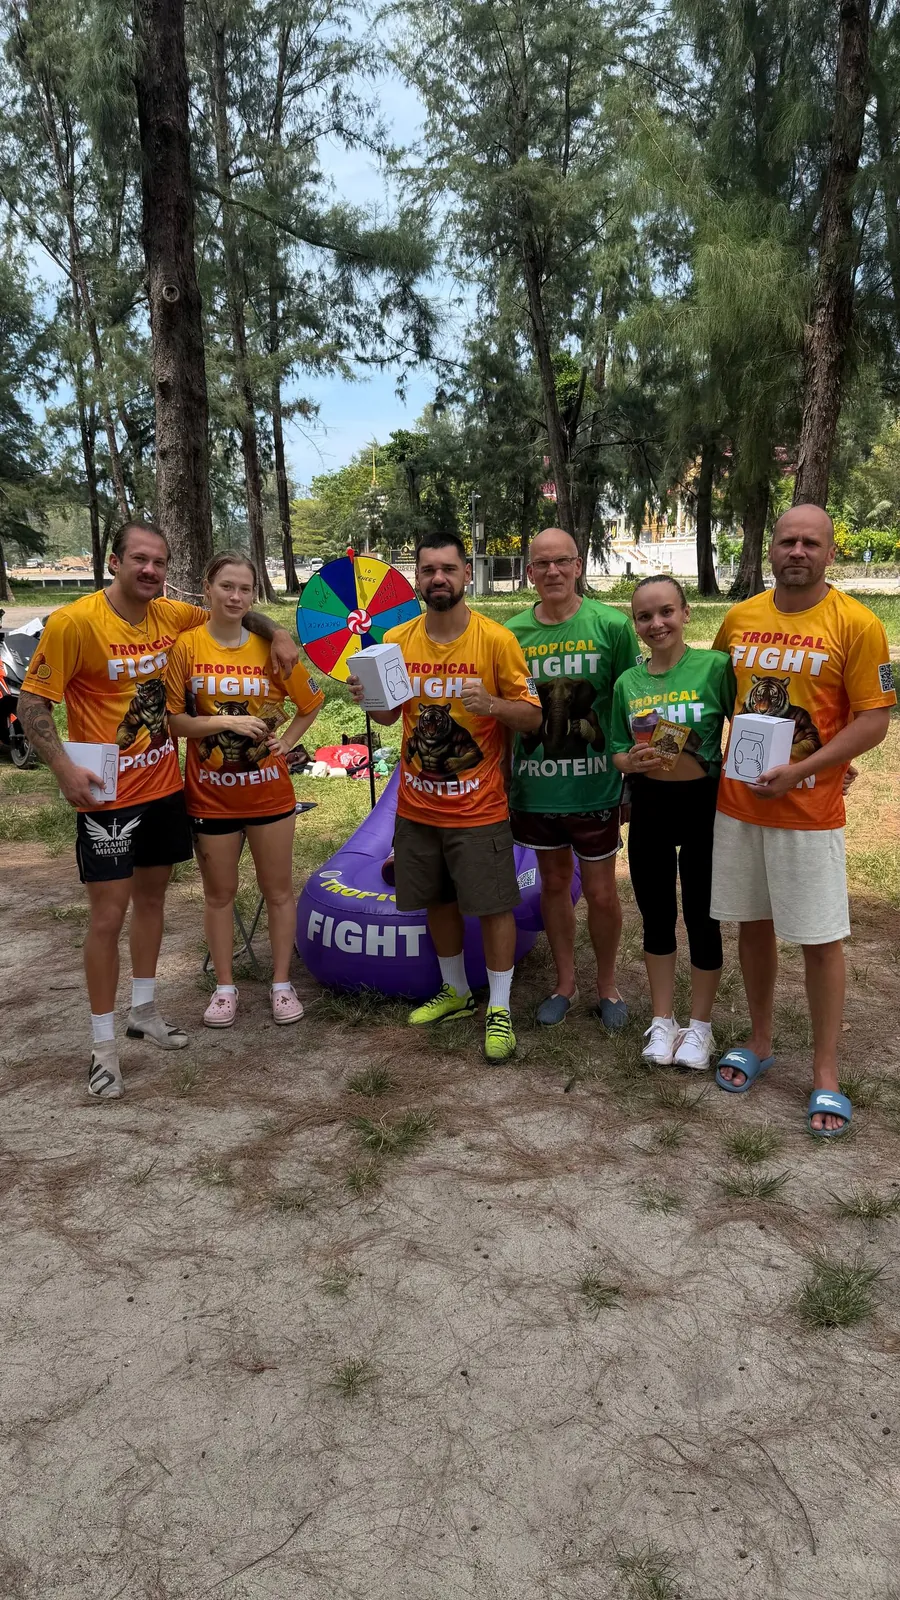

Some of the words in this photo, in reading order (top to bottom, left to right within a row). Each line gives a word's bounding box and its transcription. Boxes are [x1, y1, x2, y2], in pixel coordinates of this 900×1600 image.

[110, 634, 176, 656] TROPICAL
[741, 631, 825, 650] TROPICAL
[107, 652, 168, 681] FIGH
[195, 663, 268, 676] TROPICAL
[405, 662, 478, 675] TROPICAL
[527, 653, 601, 679] IGHT
[731, 645, 830, 677] FIGHT
[190, 676, 270, 697] FIGHT
[408, 676, 483, 698] IGH
[629, 689, 700, 709] TROPICAL
[199, 765, 280, 787] PROTEIN
[518, 755, 607, 777] PROTEIN
[404, 771, 481, 796] PROTEIN
[319, 878, 396, 902] TROPI
[307, 909, 427, 957] FIGHT
